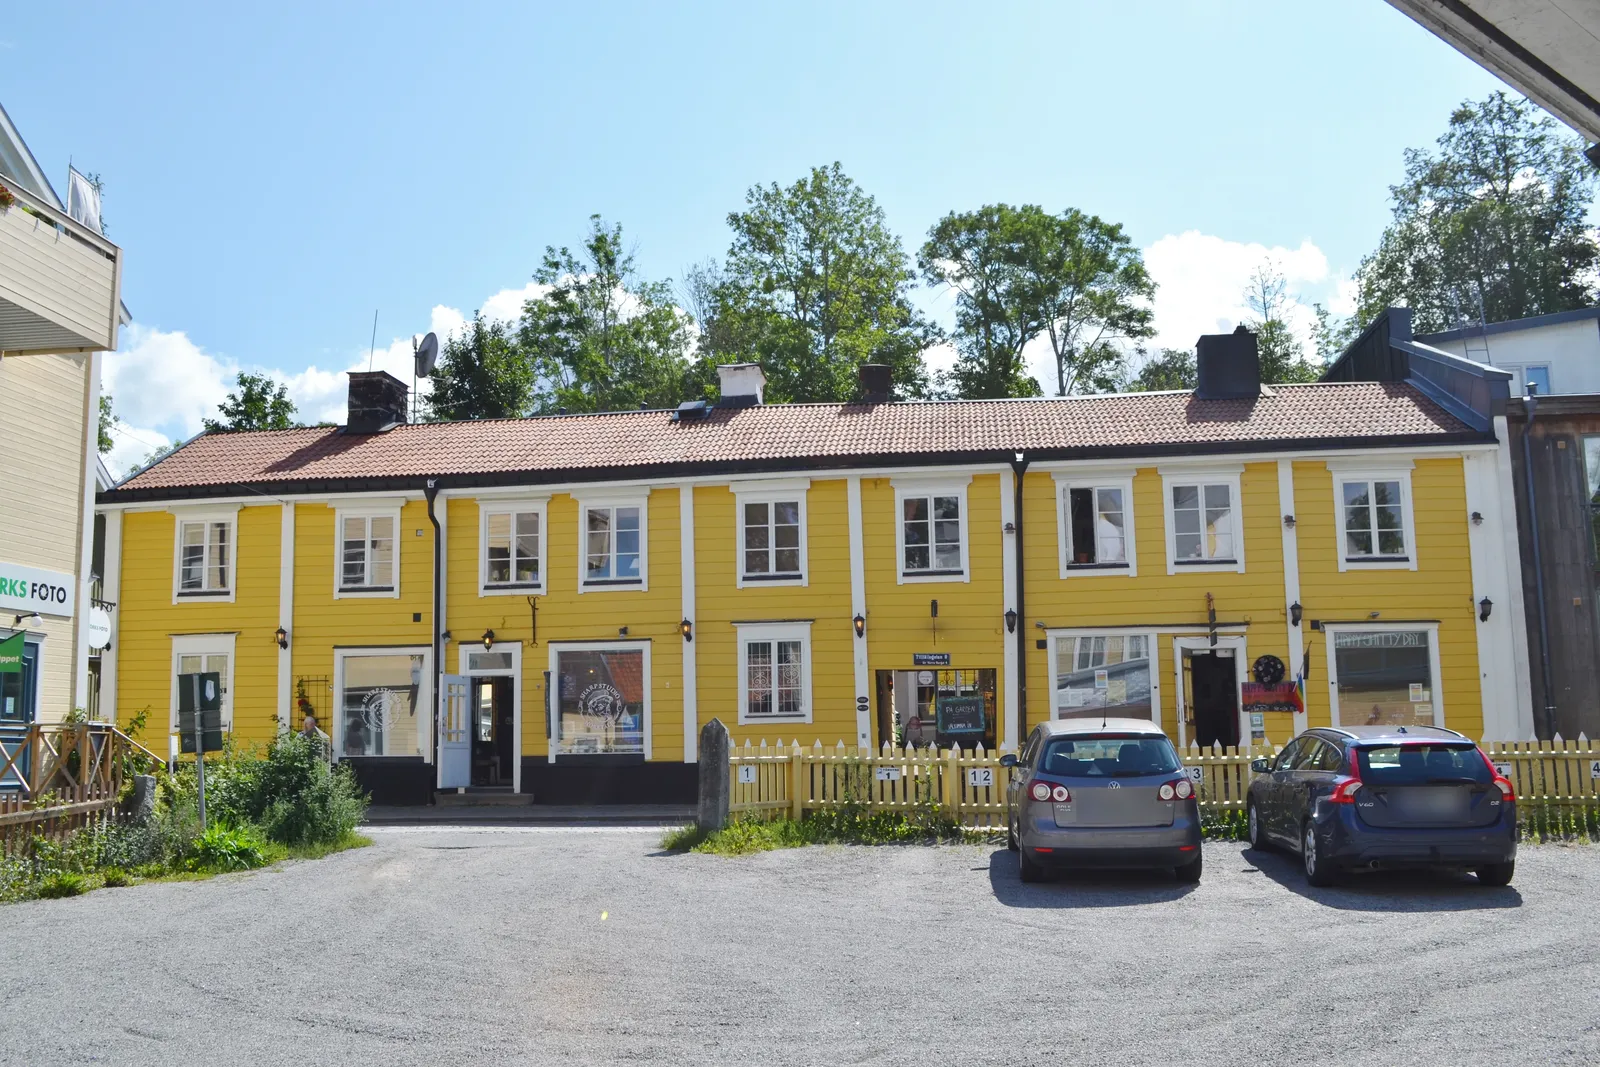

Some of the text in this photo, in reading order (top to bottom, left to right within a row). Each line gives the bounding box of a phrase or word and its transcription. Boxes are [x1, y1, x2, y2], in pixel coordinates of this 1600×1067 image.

[31, 582, 67, 604] FOTO
[1403, 632, 1420, 646] DAY
[580, 683, 598, 700] SHARP
[598, 683, 621, 700] STUDIO
[744, 767, 749, 779] 1
[1193, 767, 1201, 779] 3
[1592, 762, 1600, 774] 4
[885, 772, 890, 780] 1
[971, 770, 991, 782] 1 2
